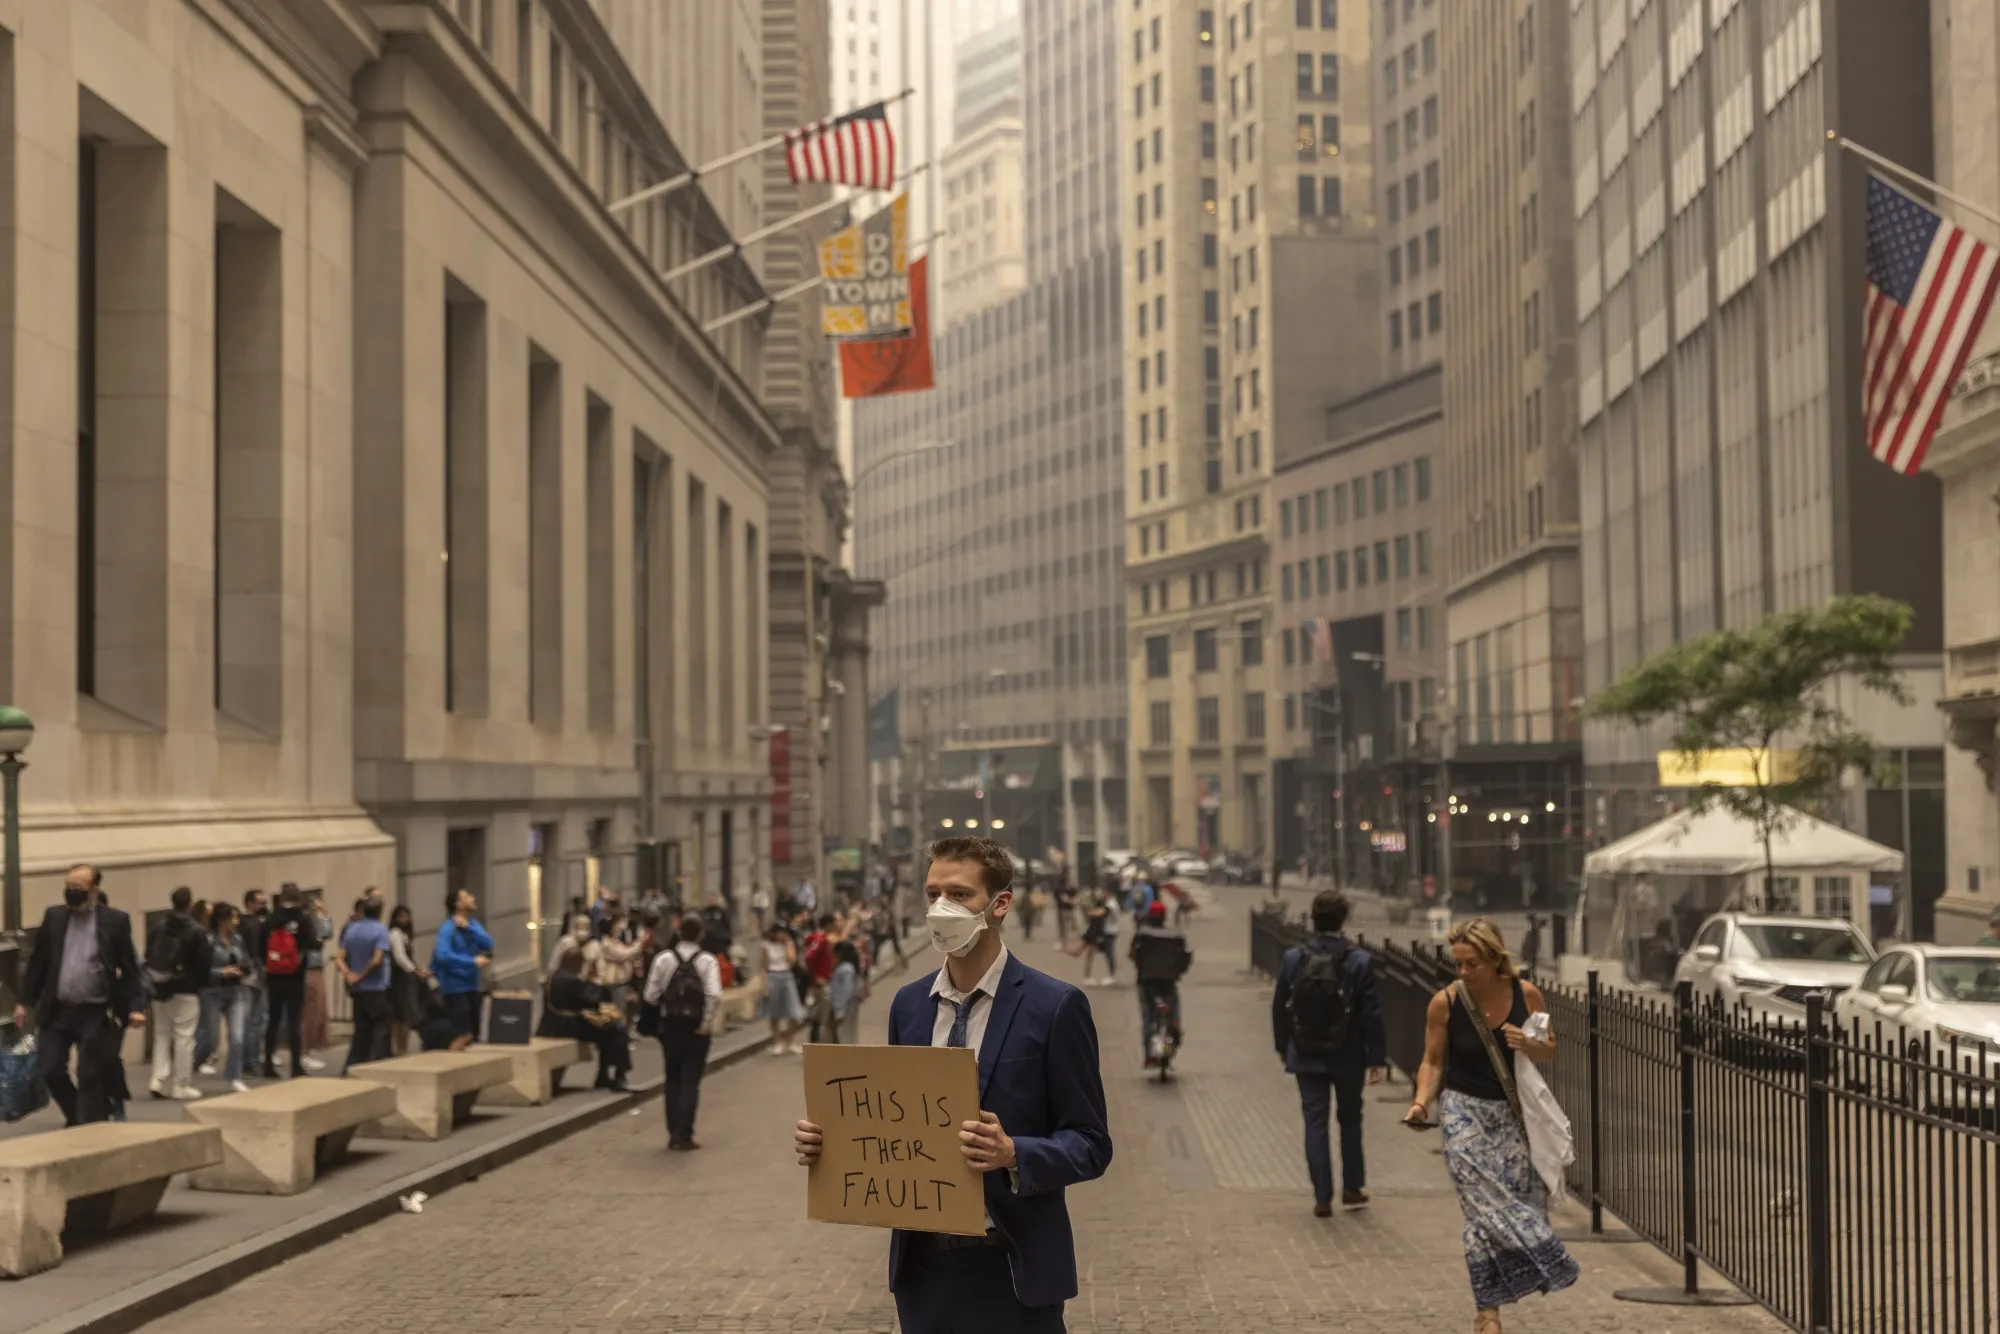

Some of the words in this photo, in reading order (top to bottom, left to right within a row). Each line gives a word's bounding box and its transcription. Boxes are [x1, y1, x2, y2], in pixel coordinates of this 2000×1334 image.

[824, 279, 908, 304] TOWN
[826, 1075, 905, 1122] THIS
[922, 1093, 952, 1127] IS
[852, 1136, 936, 1164] THEIR
[843, 1172, 956, 1212] FAULT
